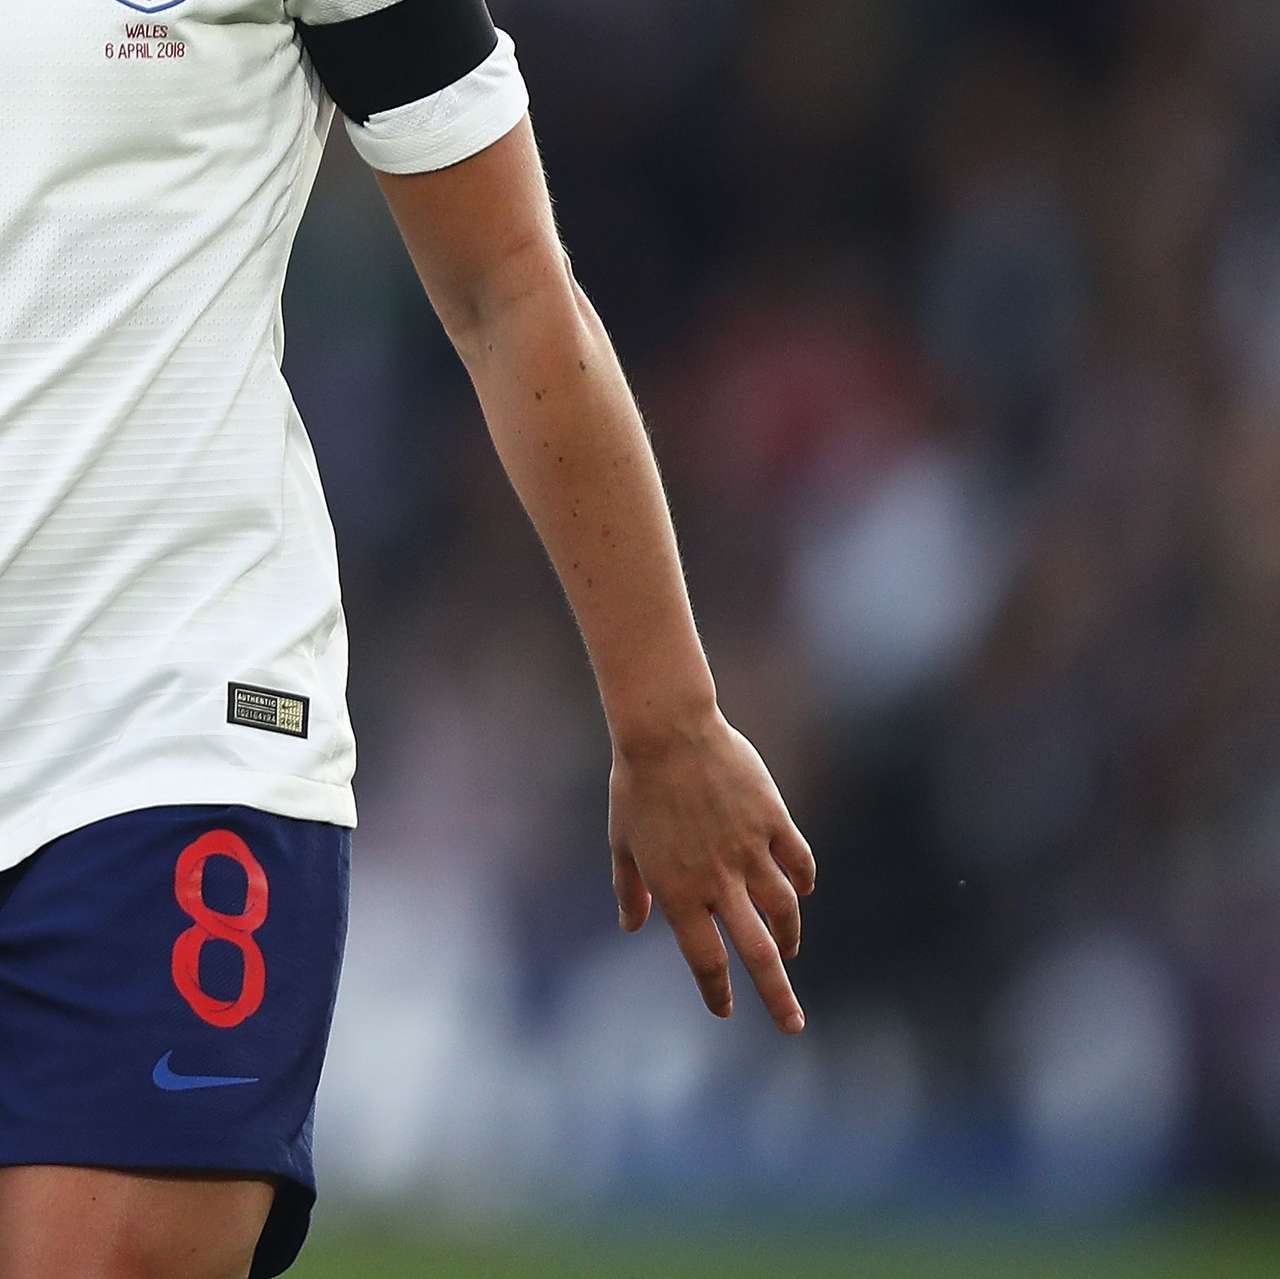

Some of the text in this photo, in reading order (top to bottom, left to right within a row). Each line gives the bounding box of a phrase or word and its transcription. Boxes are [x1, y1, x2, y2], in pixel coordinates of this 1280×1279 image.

[126, 23, 168, 38] WALES
[105, 41, 185, 59] 6 APRIL 2018
[237, 693, 277, 708] AUTHENTIC
[171, 828, 269, 1028] 8
